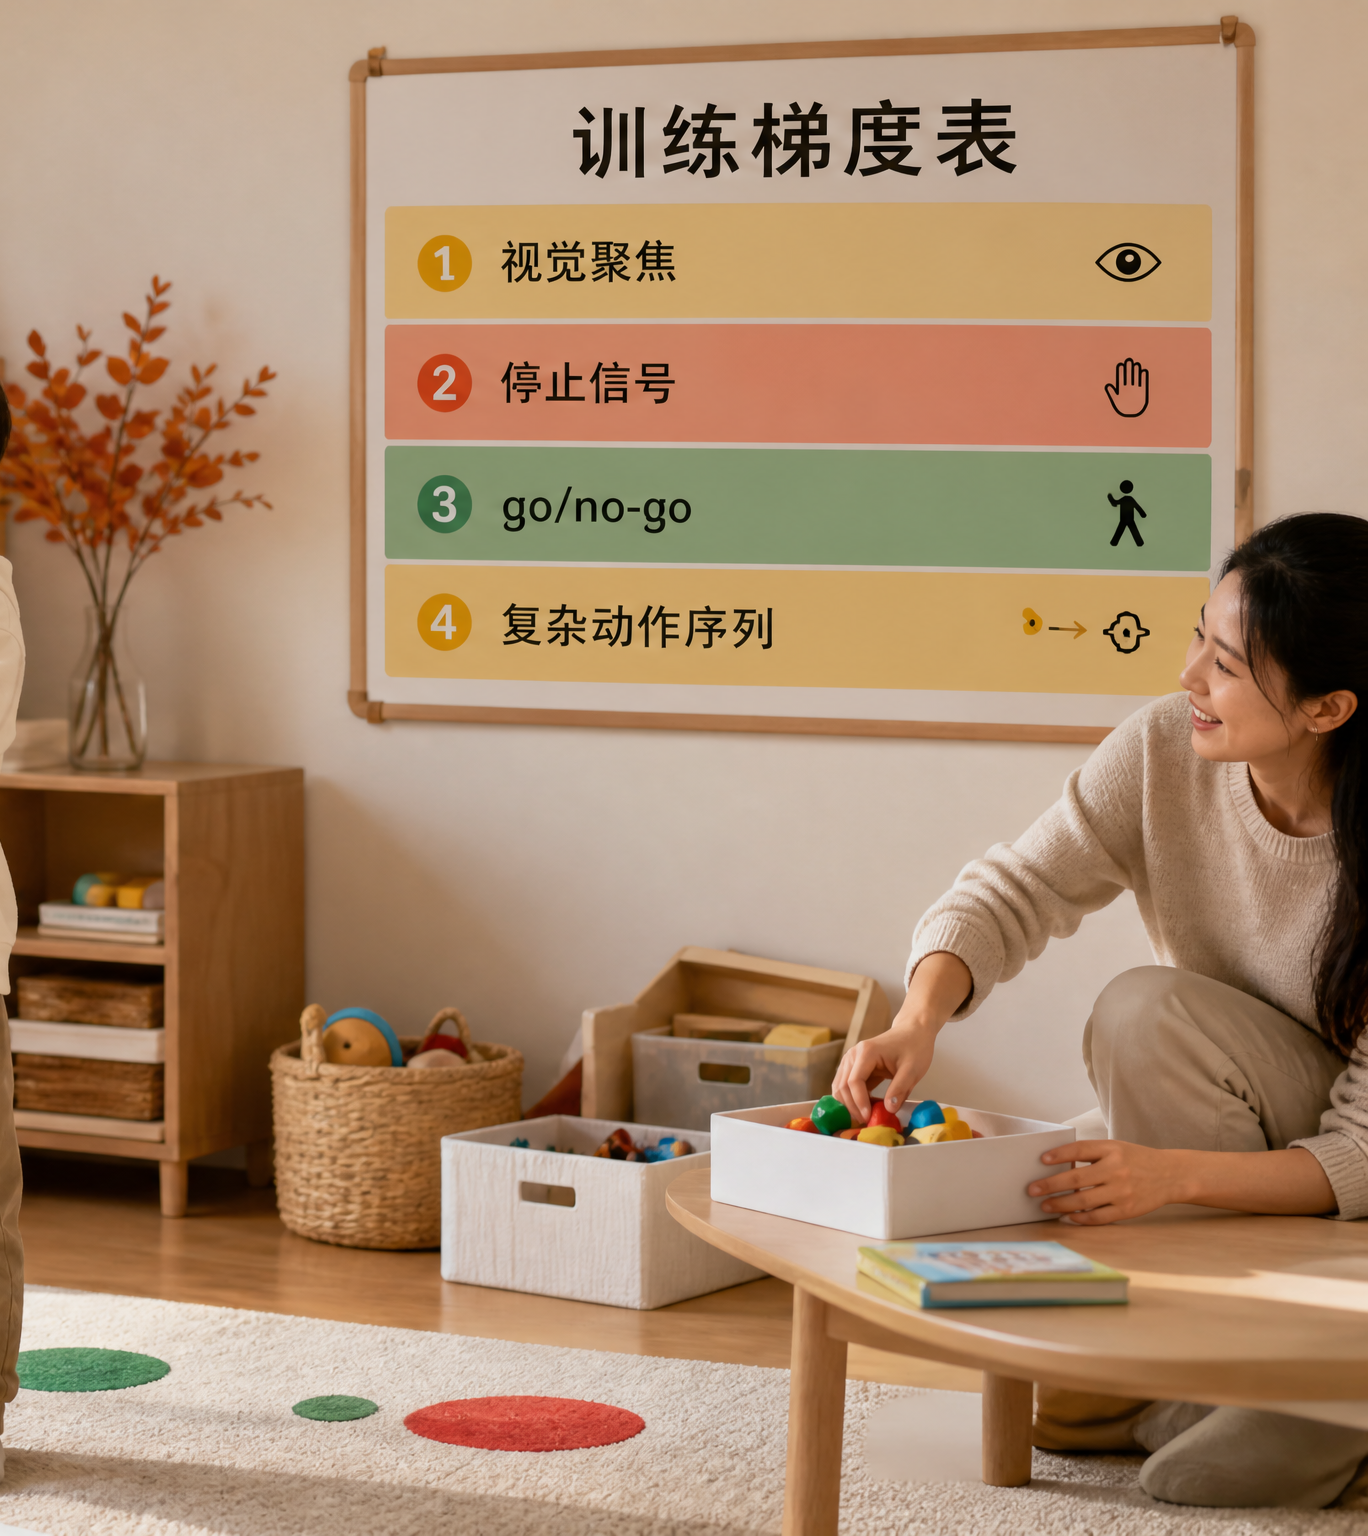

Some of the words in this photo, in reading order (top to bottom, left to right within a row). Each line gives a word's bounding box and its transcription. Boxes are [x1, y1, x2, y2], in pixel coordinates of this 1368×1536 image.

[573, 99, 1016, 178] 训练梯度表
[434, 247, 455, 281] 1
[501, 240, 675, 283] 视觉聚焦
[433, 365, 456, 401] 2
[501, 361, 675, 404] 停止信号
[432, 485, 457, 522] 3
[502, 487, 692, 534] go/no-go
[430, 604, 457, 640] 4
[502, 602, 773, 650] 复杂动作序列
